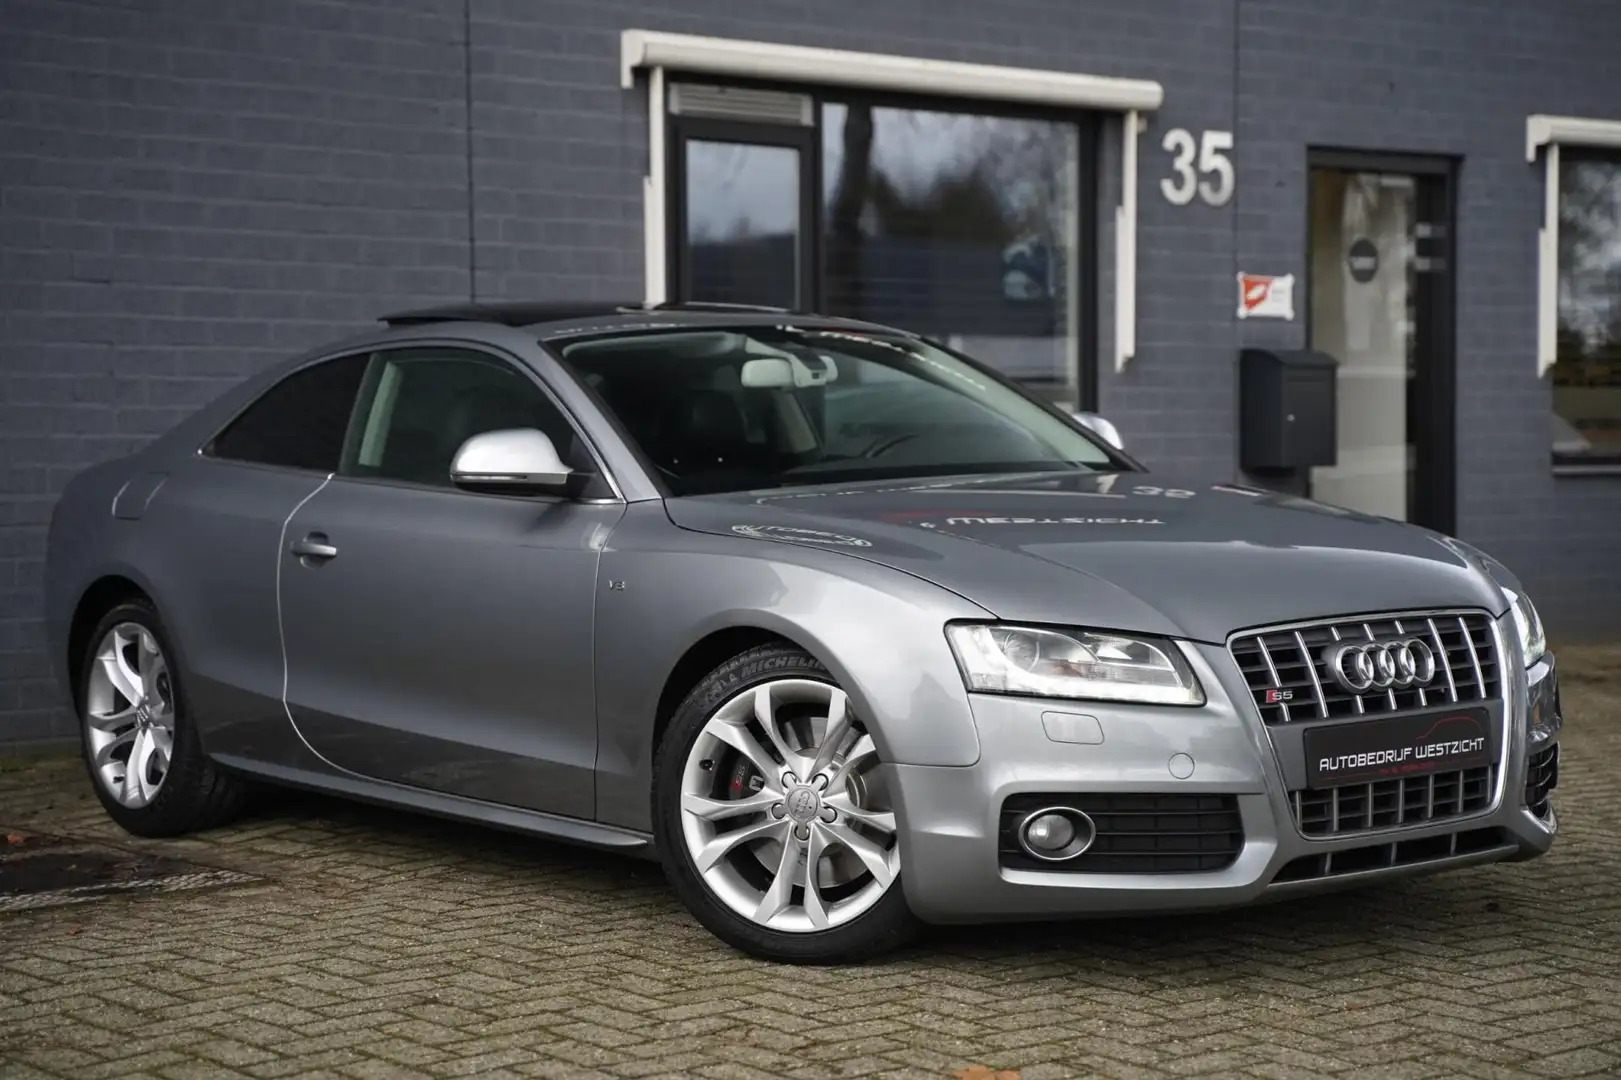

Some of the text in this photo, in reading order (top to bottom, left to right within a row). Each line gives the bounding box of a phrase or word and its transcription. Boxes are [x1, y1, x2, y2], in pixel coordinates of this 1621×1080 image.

[1160, 128, 1235, 206] 35
[1271, 691, 1293, 701] S5
[1319, 747, 1412, 771] AUTOBEDRIJF
[1415, 737, 1485, 759] WESTZICHT
